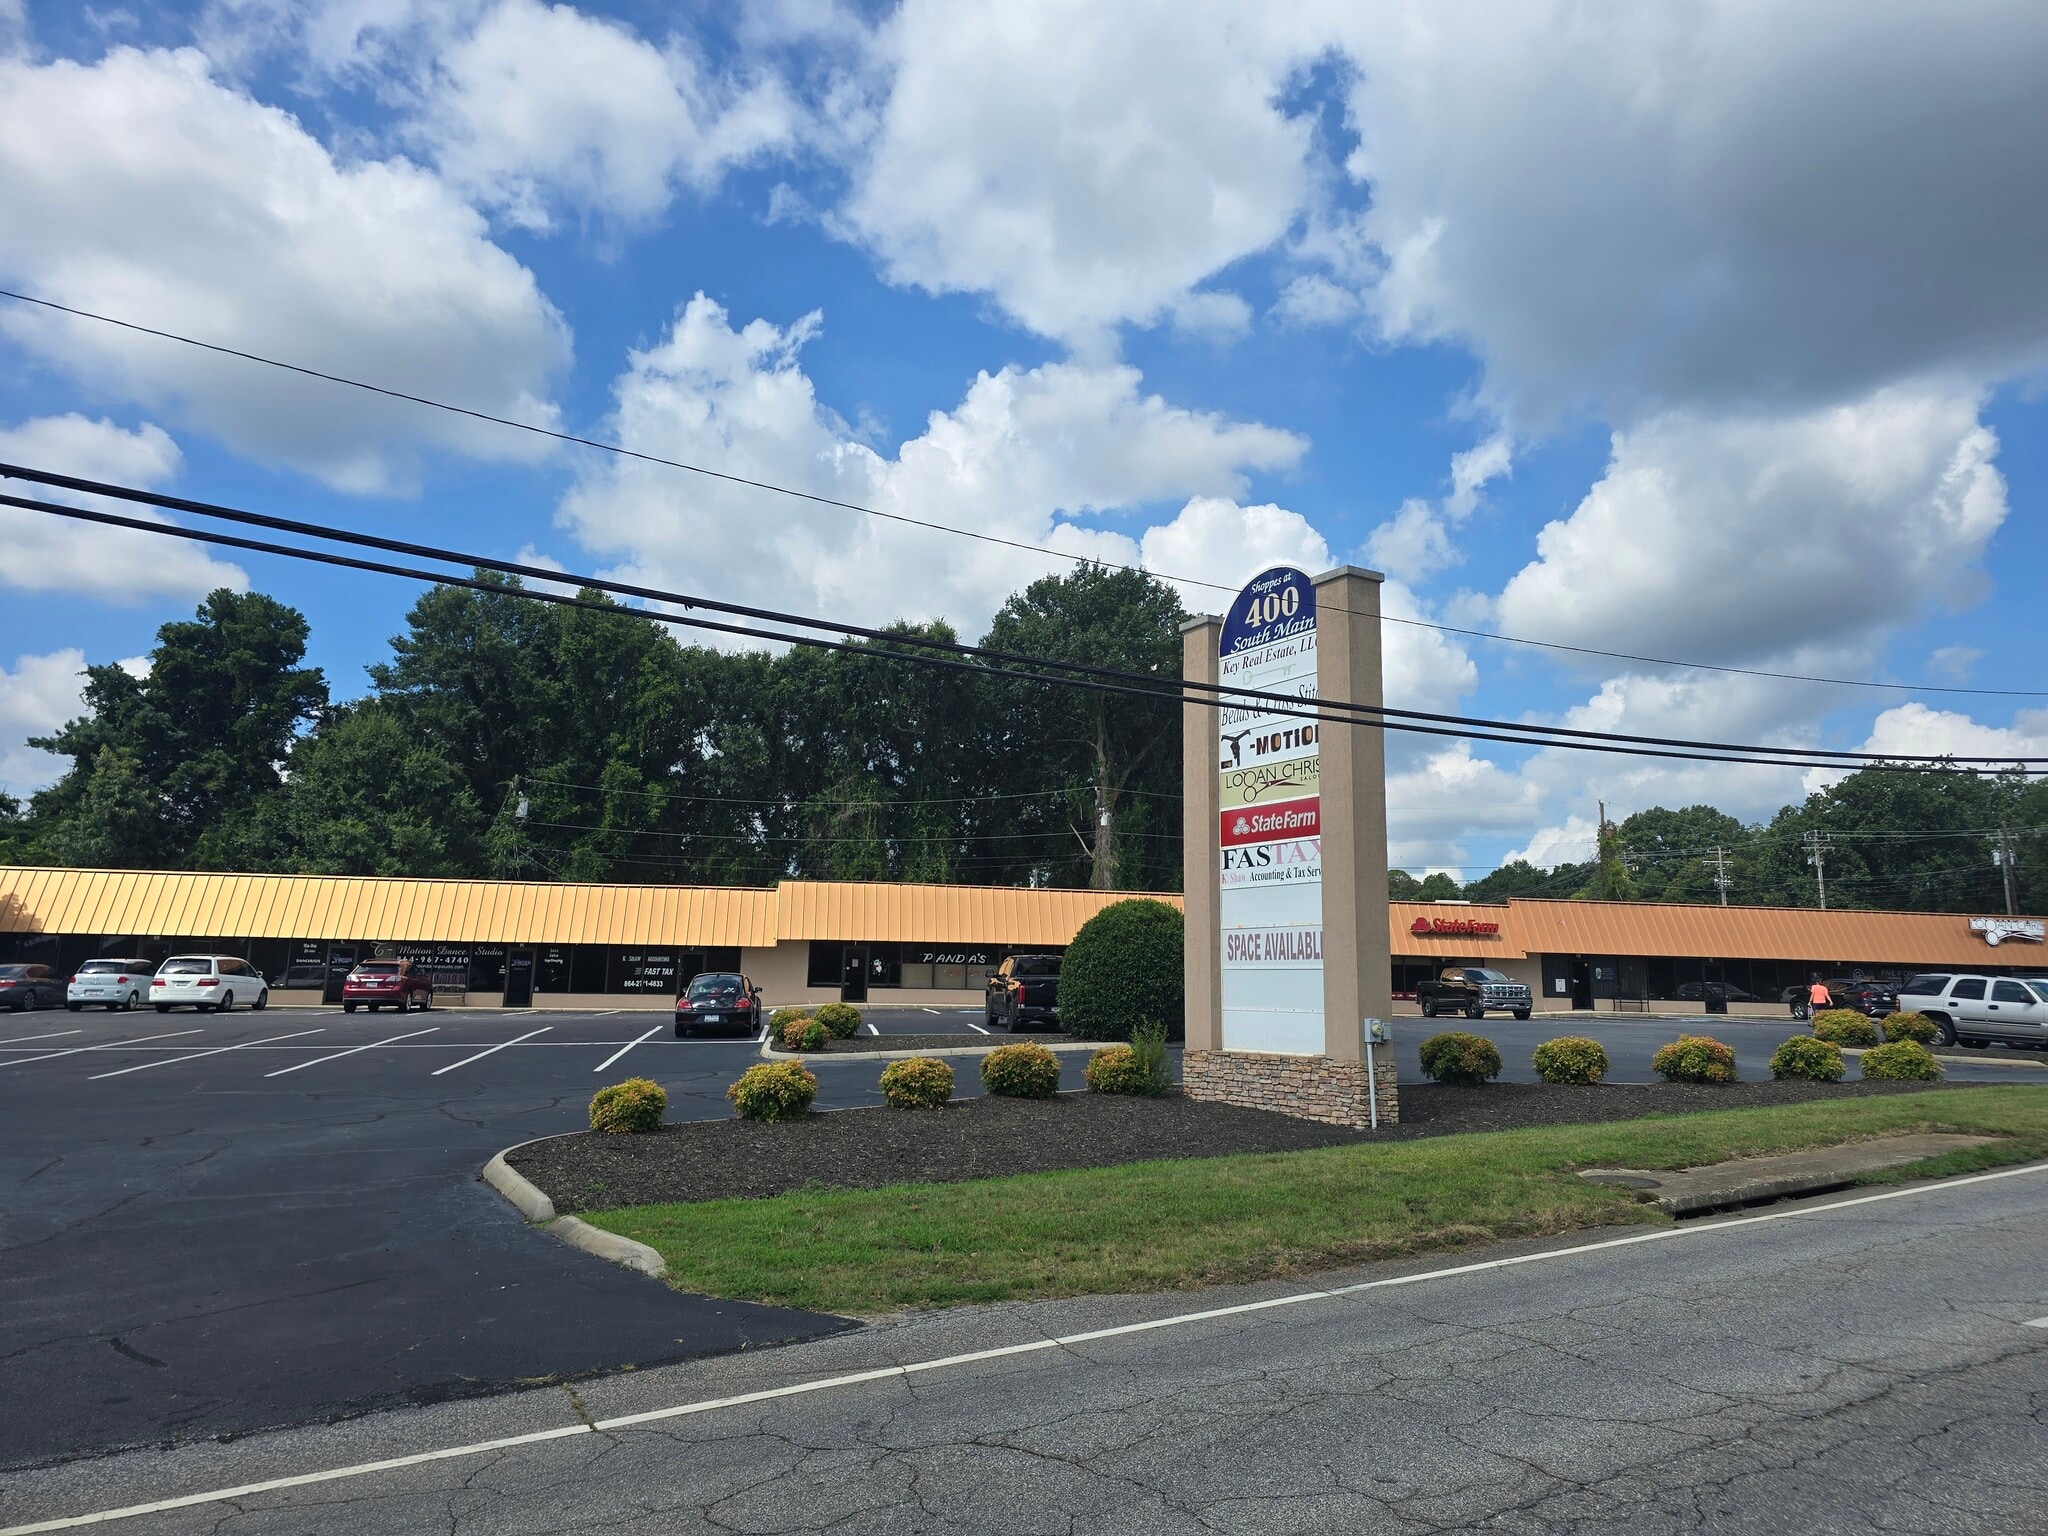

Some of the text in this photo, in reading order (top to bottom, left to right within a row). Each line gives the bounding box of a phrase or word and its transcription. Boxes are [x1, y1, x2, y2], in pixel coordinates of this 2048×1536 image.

[1250, 571, 1292, 595] Shoppes at
[1244, 586, 1299, 628] 400
[1230, 616, 1315, 654] South Main
[1222, 660, 1240, 676] Key
[1242, 651, 1263, 670] Real
[1265, 645, 1297, 663] Estate,
[1230, 871, 1246, 884] Shaw
[1249, 868, 1285, 882] Accounting
[1285, 867, 1292, 879] &
[1294, 866, 1305, 879] Tax
[398, 945, 432, 954] Motion
[437, 945, 469, 955] Dance
[474, 945, 504, 956] Studio
[1227, 933, 1262, 961] SPACE
[644, 967, 674, 975] FAST TAX
